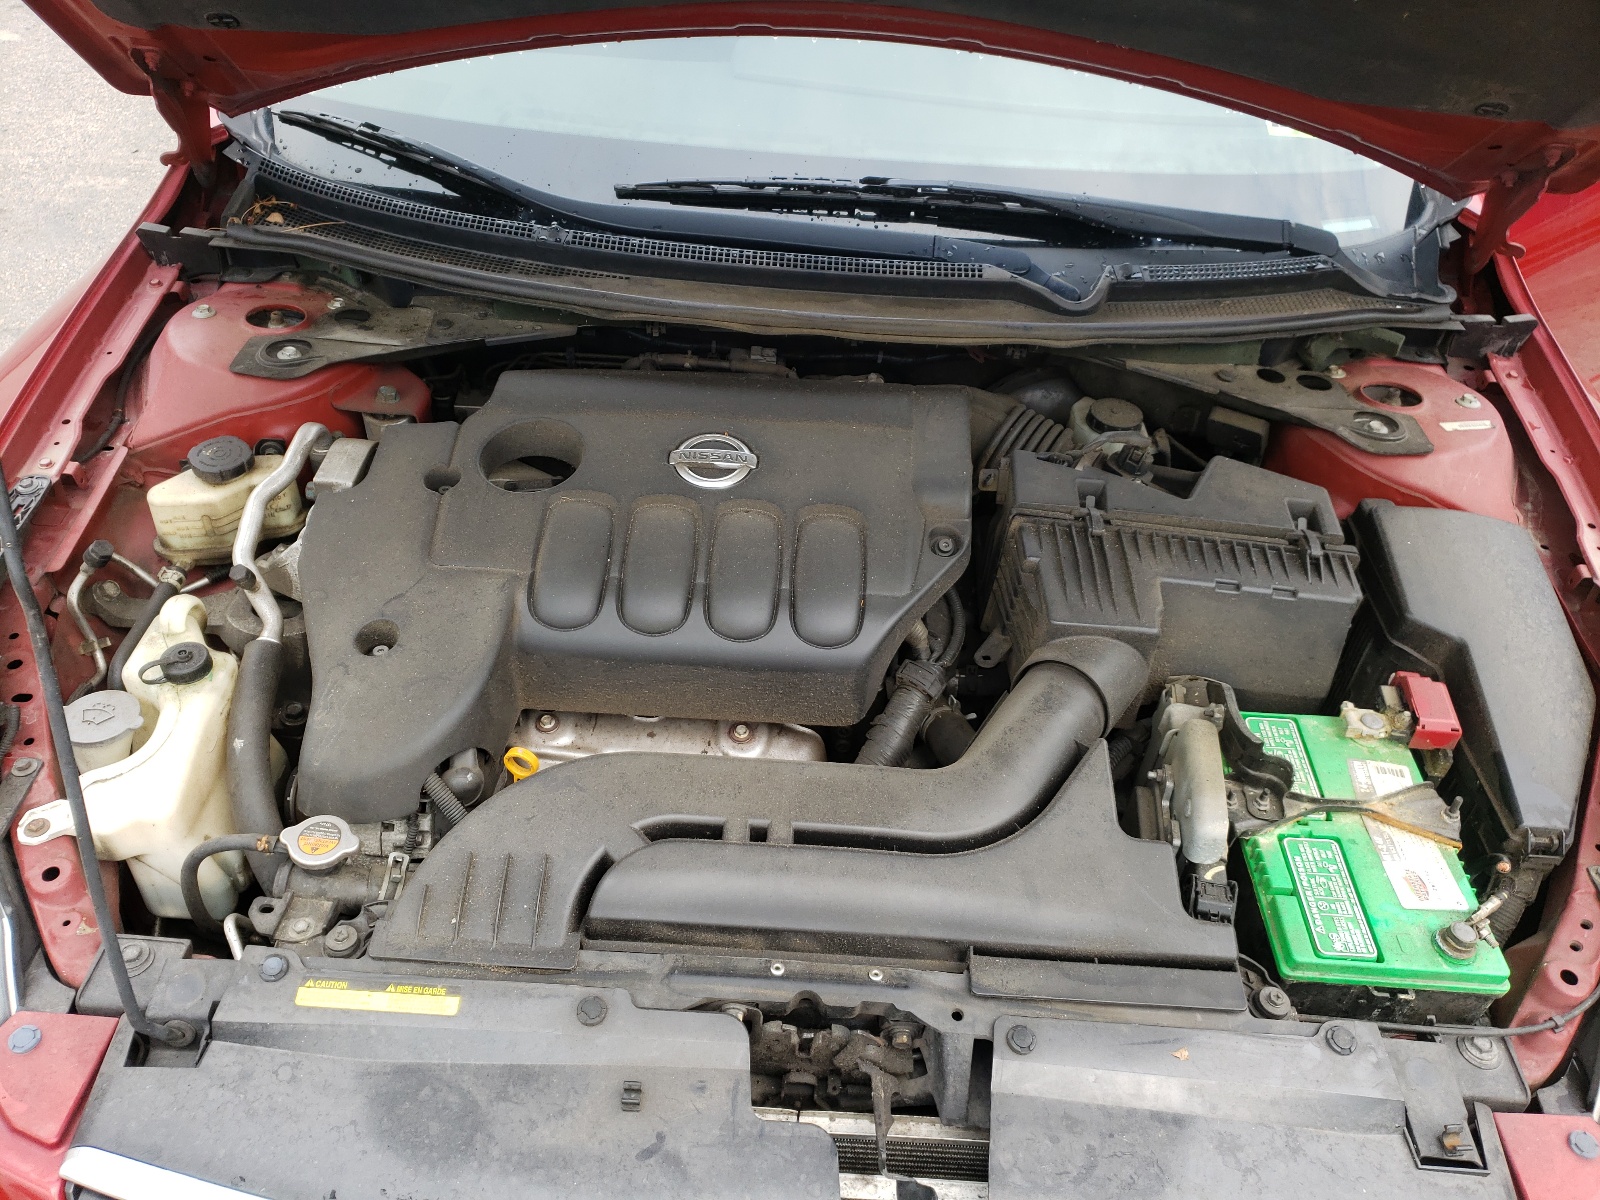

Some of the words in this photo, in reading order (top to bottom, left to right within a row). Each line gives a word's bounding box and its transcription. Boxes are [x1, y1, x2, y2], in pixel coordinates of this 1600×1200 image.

[679, 451, 748, 463] NISSAN
[315, 980, 348, 989] CAUTION
[396, 985, 413, 994] MISE
[423, 987, 447, 996] GARDE
